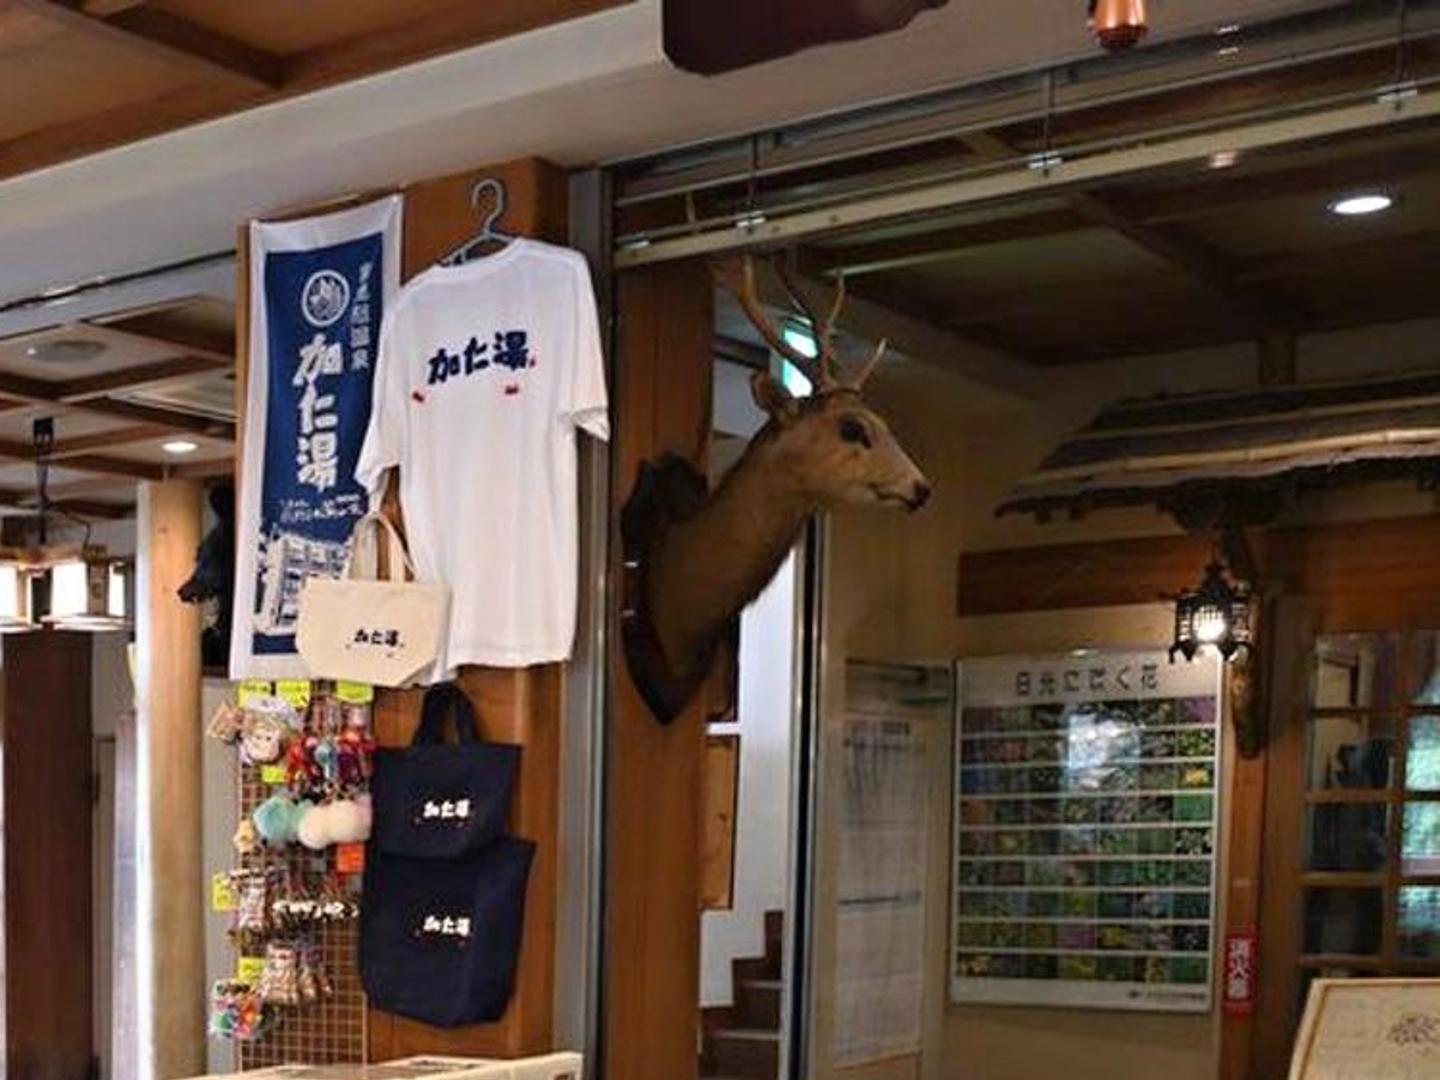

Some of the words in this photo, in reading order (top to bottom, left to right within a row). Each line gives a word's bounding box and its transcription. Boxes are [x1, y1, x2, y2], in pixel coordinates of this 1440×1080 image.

[426, 330, 529, 385] 加仁湯
[292, 332, 344, 493] 加仁湯
